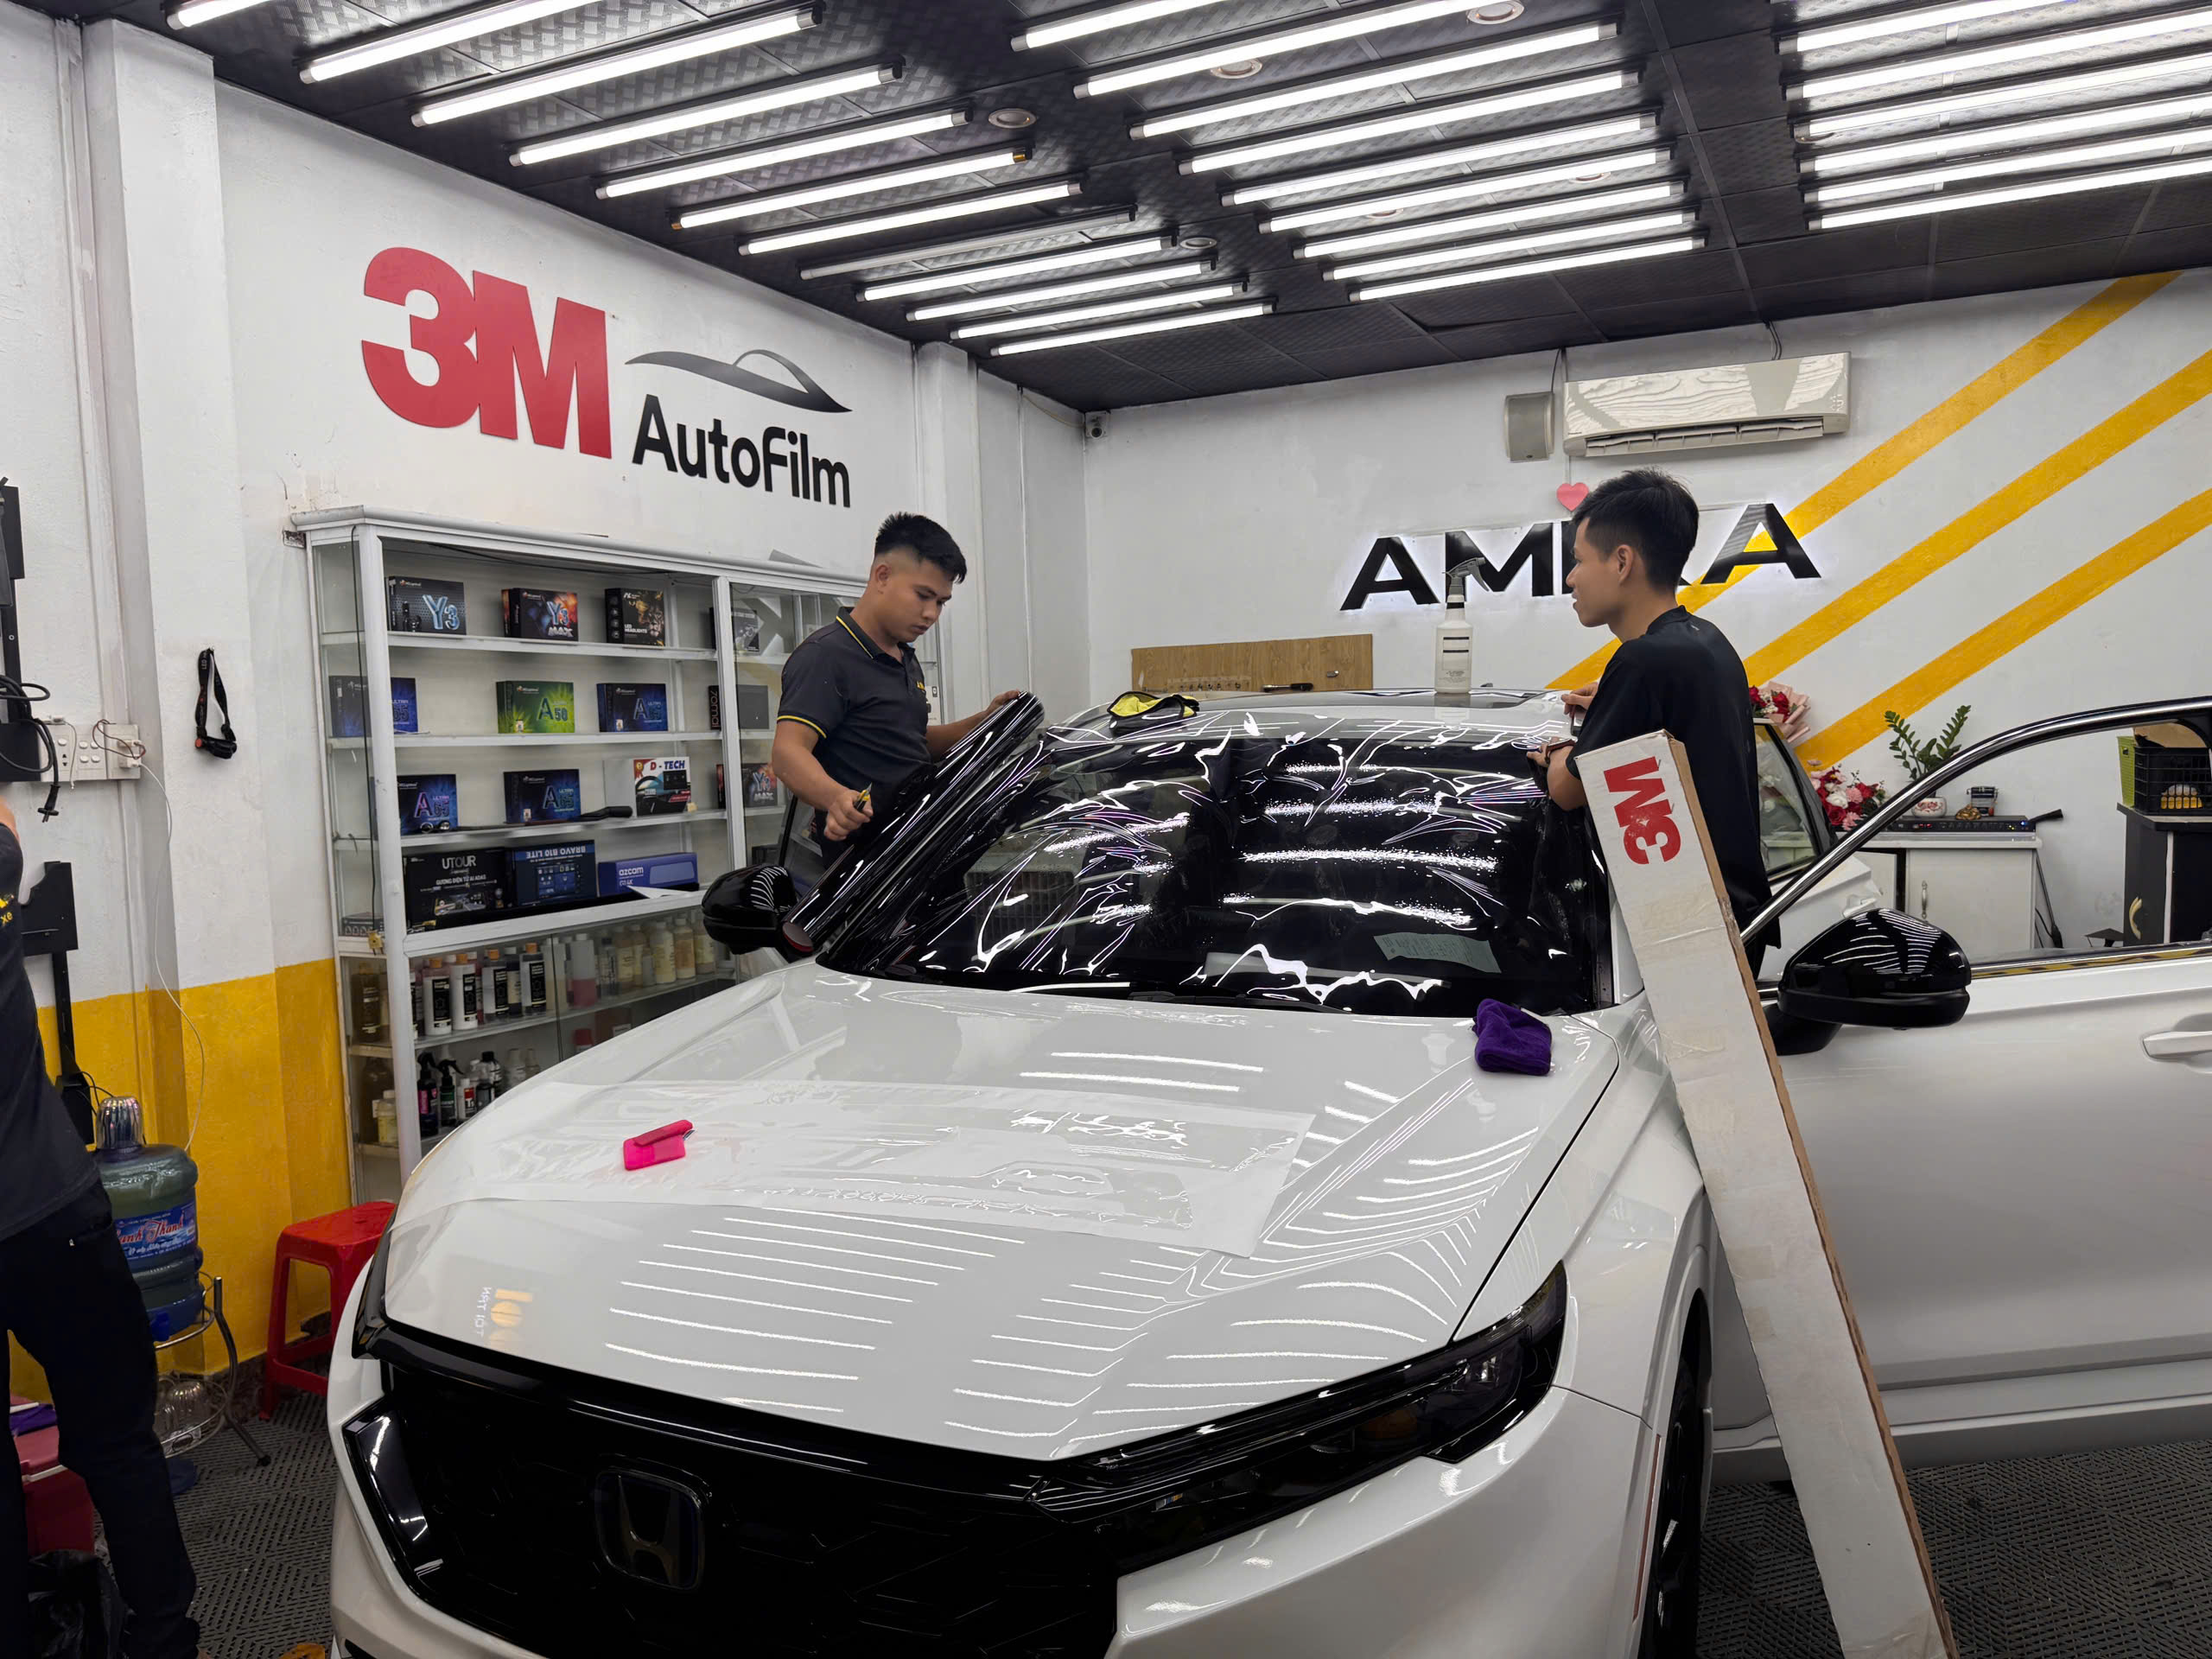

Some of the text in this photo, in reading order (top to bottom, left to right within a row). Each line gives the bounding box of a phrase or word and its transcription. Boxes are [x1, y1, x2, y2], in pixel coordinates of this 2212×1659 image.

[361, 246, 613, 461] 3M
[632, 393, 851, 508] AutoFilm
[422, 594, 461, 631] Y3
[546, 601, 569, 626] Y3
[547, 626, 574, 638] MAX
[664, 760, 685, 770] TECH
[1604, 756, 1681, 865] 3M
